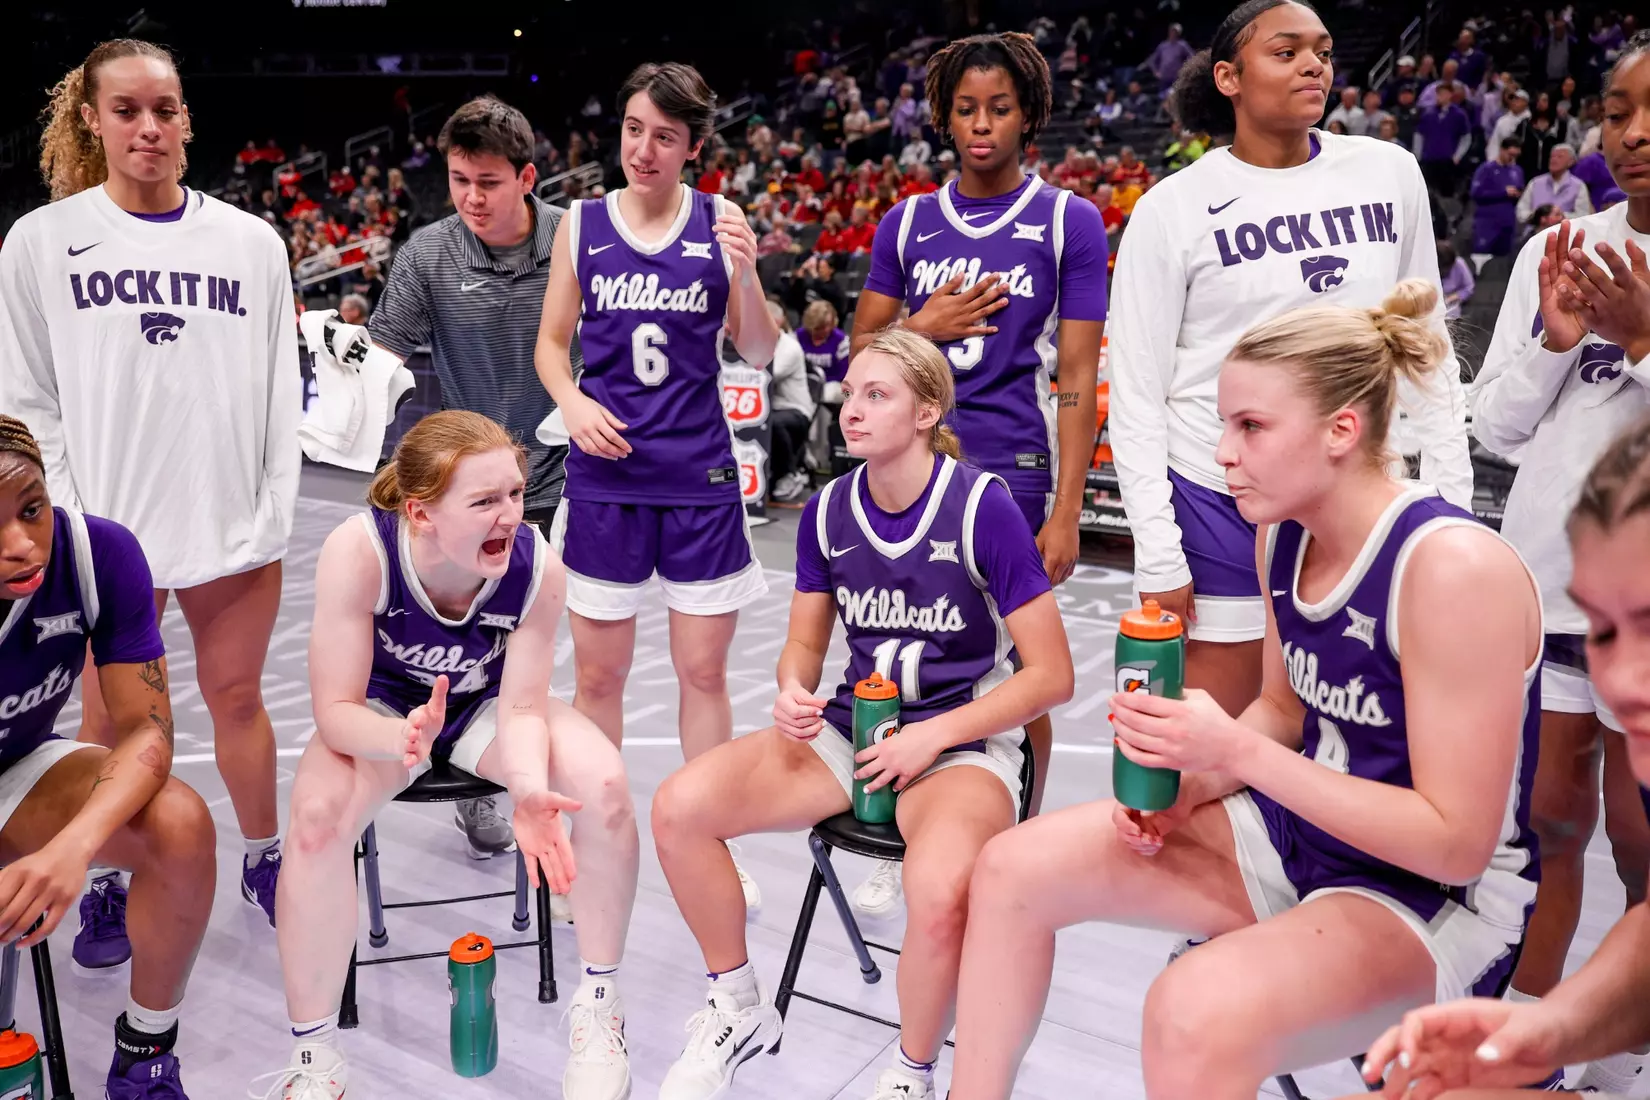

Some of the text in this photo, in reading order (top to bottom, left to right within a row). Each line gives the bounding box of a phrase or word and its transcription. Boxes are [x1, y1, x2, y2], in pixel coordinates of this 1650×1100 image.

[1213, 202, 1398, 268] LOCK IT IN.
[69, 269, 248, 317] LOCK IT IN.
[590, 271, 709, 314] Wildcats
[631, 322, 670, 387] 6
[33, 610, 84, 645] XII
[835, 585, 968, 633] Wildcats
[0, 662, 73, 720] cats
[871, 638, 926, 702] 11
